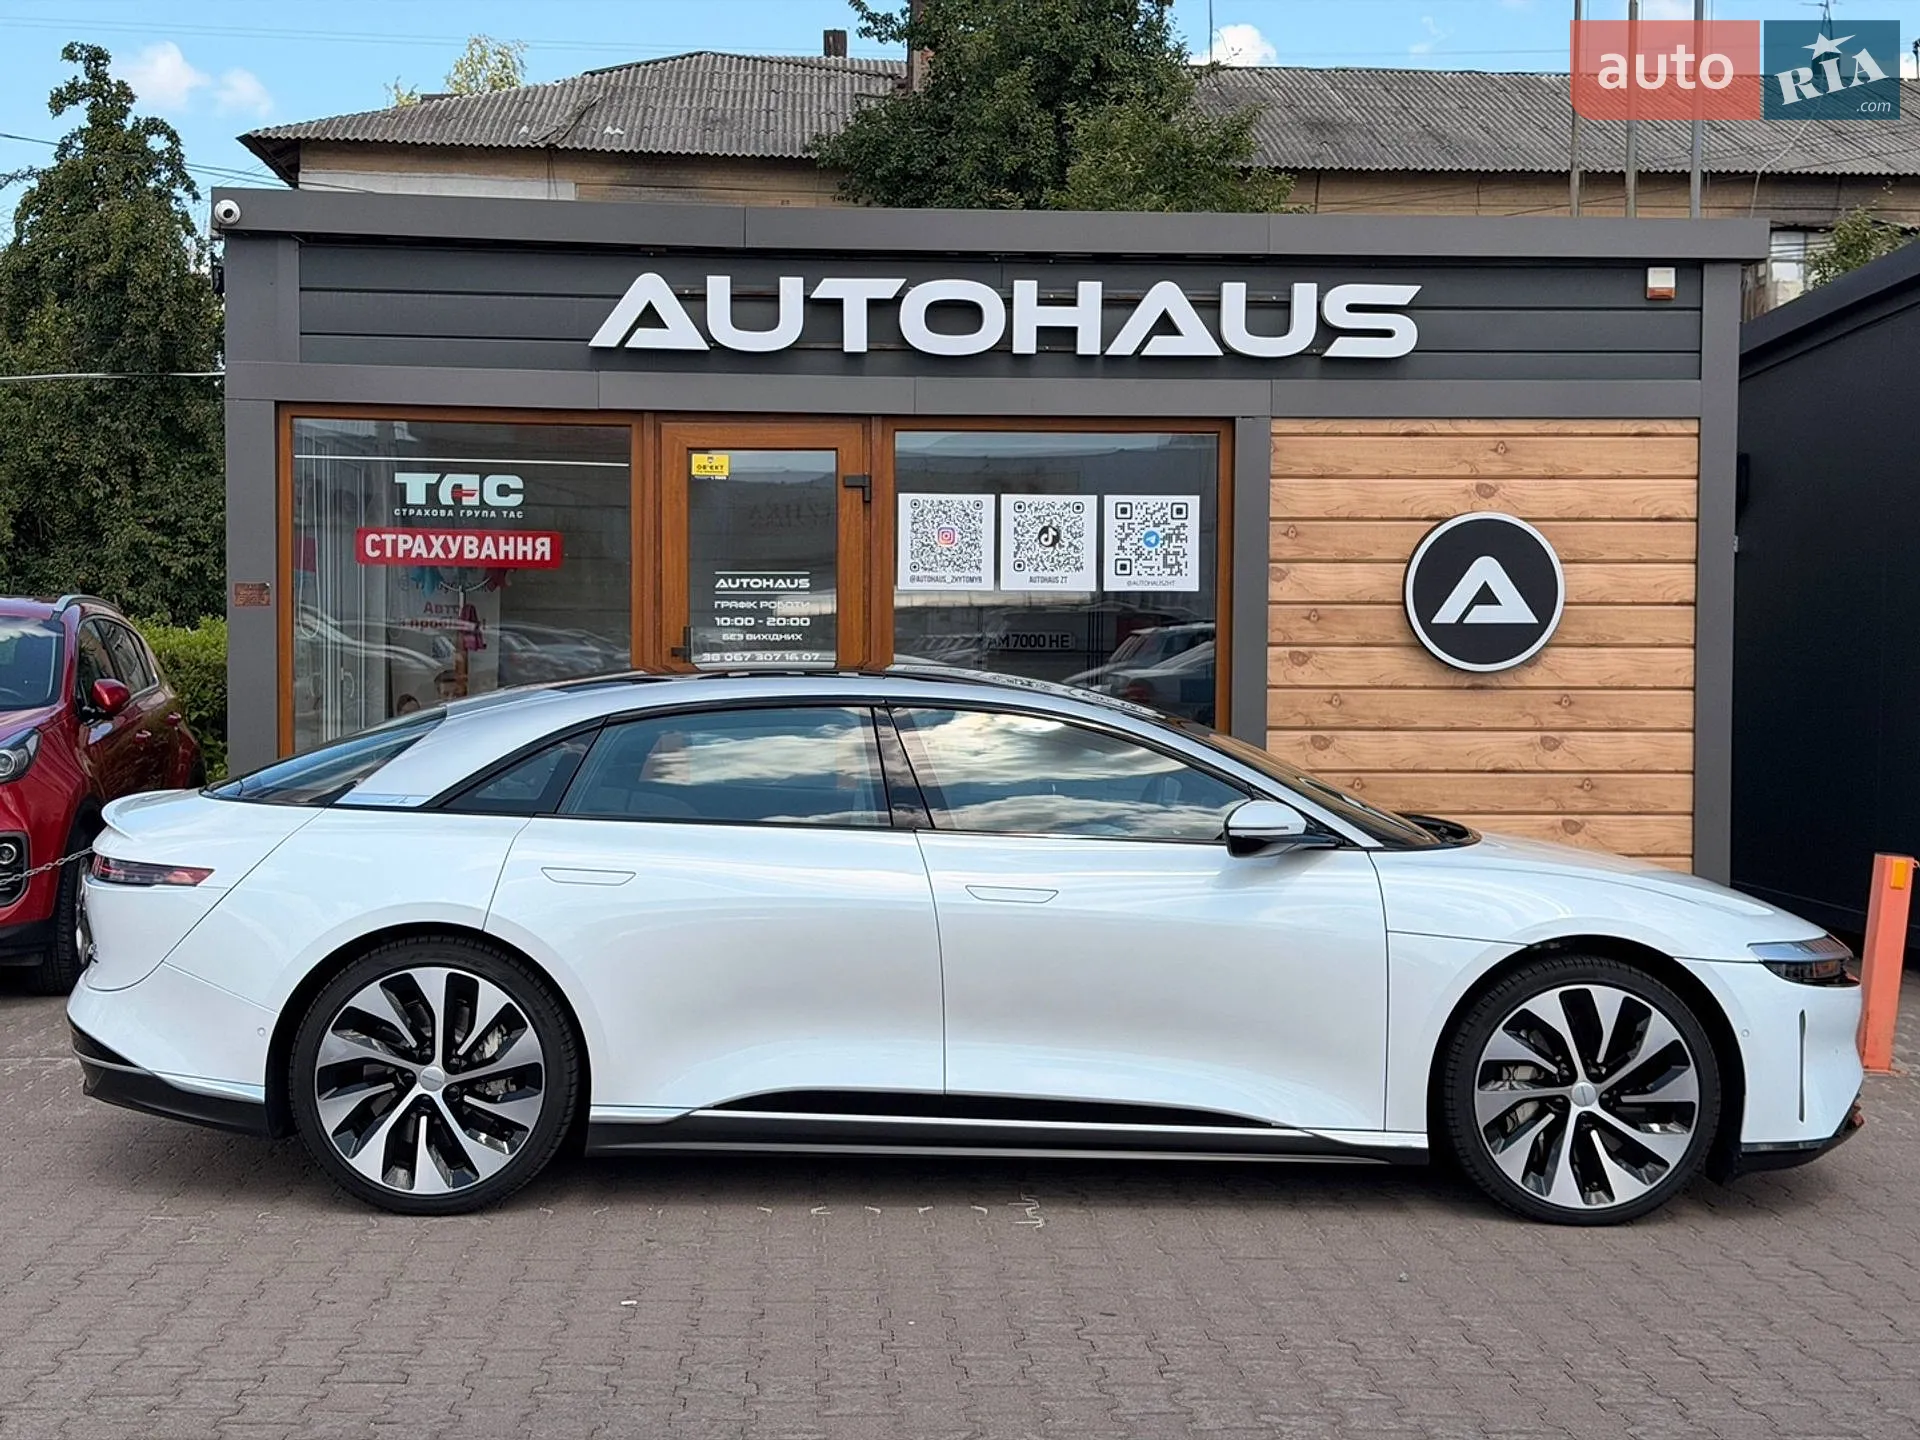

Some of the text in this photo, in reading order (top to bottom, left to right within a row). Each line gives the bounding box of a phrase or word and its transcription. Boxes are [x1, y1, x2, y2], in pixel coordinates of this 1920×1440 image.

[588, 272, 1422, 358] AUTOHAUS
[394, 508, 524, 519] СТРАХОВА ГРУПА ТАС
[365, 533, 551, 561] СТРАХУВАННЯ
[715, 578, 811, 589] AUTOHAUS
[714, 600, 757, 610] ГРАФІК
[714, 616, 755, 627] 10:00
[766, 616, 811, 627] 20:00
[722, 633, 803, 642] БЕЗ ВИХІДНИХ
[1012, 633, 1047, 649] 7000
[1049, 634, 1071, 649] HE
[802, 652, 821, 662] 07
